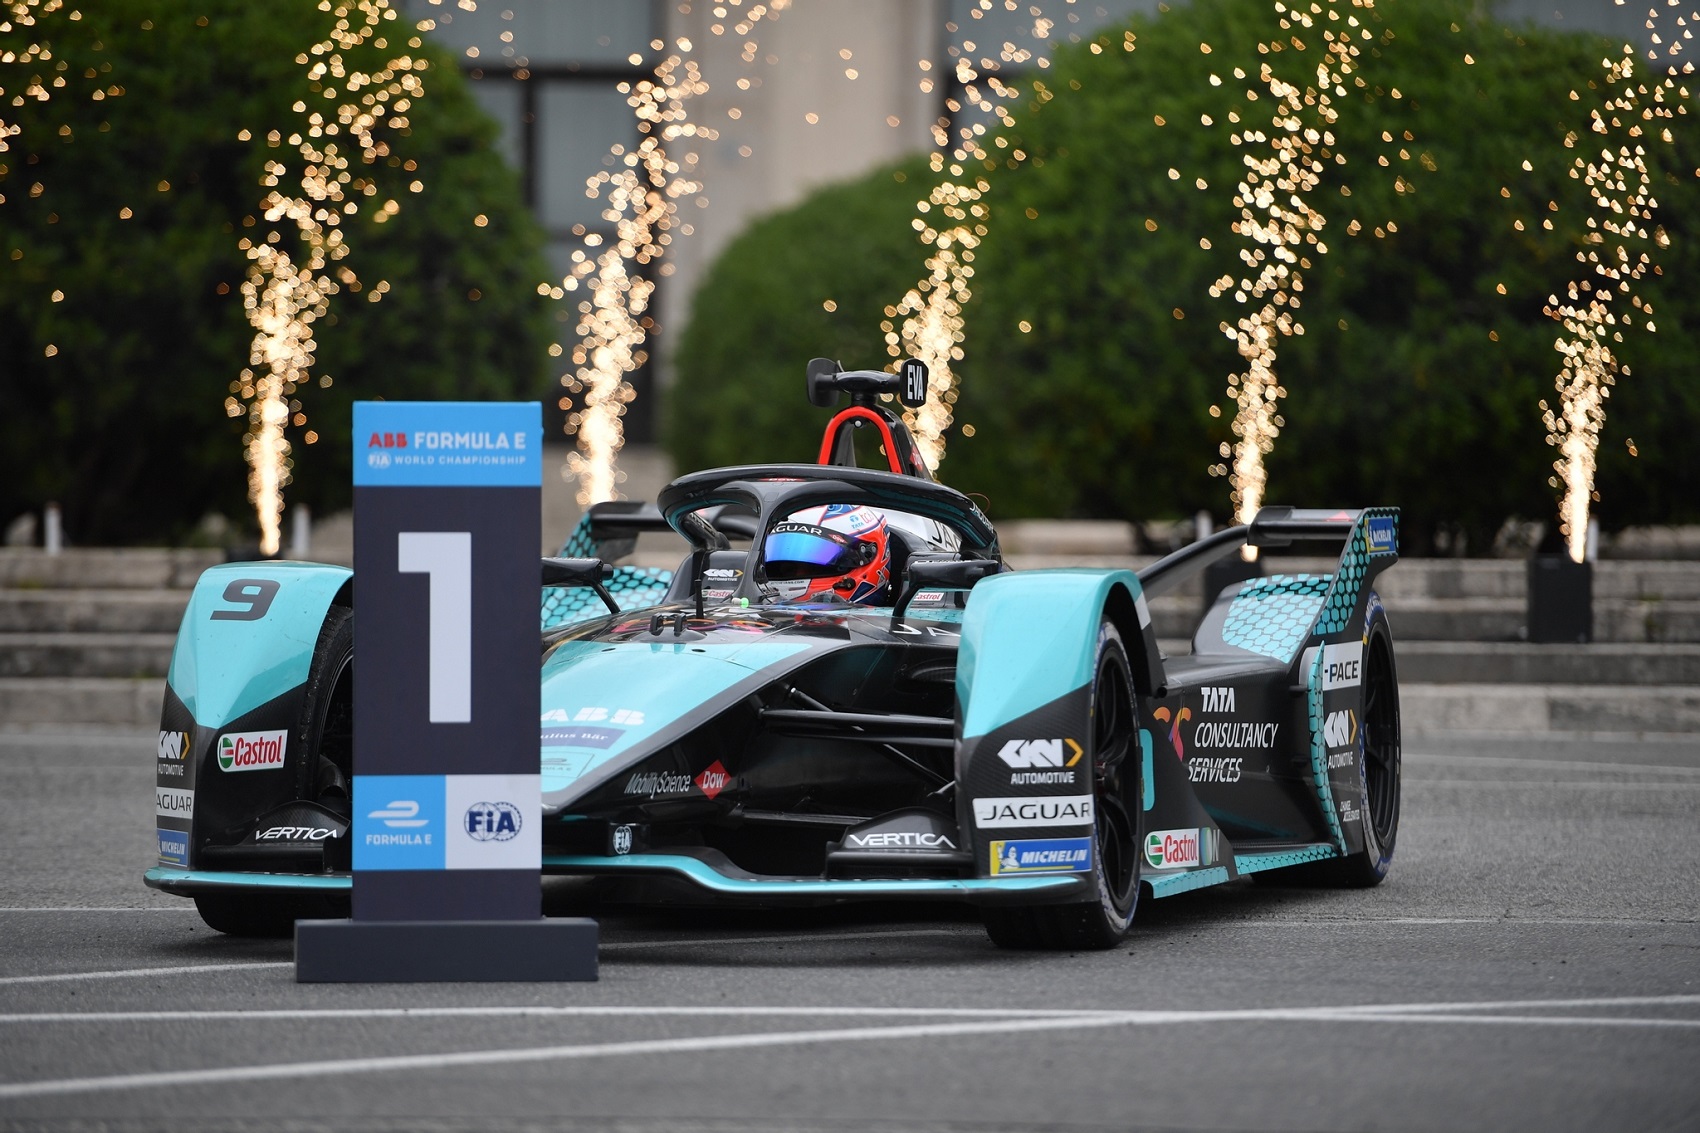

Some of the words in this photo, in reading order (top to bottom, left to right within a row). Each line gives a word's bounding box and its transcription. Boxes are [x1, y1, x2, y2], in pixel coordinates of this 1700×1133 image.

[907, 364, 924, 401] EVA
[368, 432, 408, 448] ABB
[414, 432, 510, 449] FORMULA
[514, 432, 526, 449] E
[395, 456, 435, 465] WORLD
[438, 455, 526, 465] CHAMPIONSHIP
[770, 524, 823, 536] AGUAR
[209, 578, 281, 621] 9
[398, 531, 472, 723] 1
[1201, 687, 1235, 712] TATA
[541, 707, 645, 725] ABB
[1194, 722, 1279, 748] CONSULTANCY
[1323, 709, 1349, 748] GKN
[158, 730, 183, 759] KN
[234, 735, 283, 766] Castrol
[997, 739, 1064, 768] GKN
[1328, 751, 1353, 769] AUTOMOTIVE
[158, 763, 184, 776] AUTOMOTIVE
[1010, 772, 1075, 785] AUTOMOTIVE
[1188, 757, 1243, 783] SERVICES
[157, 794, 192, 812] AGUAR
[982, 802, 1090, 821] JAGUAR
[255, 826, 338, 841] VERTICA
[366, 834, 422, 845] FORMULA
[424, 834, 432, 844] E
[849, 833, 955, 848] VERTICA
[161, 840, 186, 855] MICHELIN
[1020, 849, 1088, 864] MICHELIN
[1164, 834, 1198, 863] Castrol
